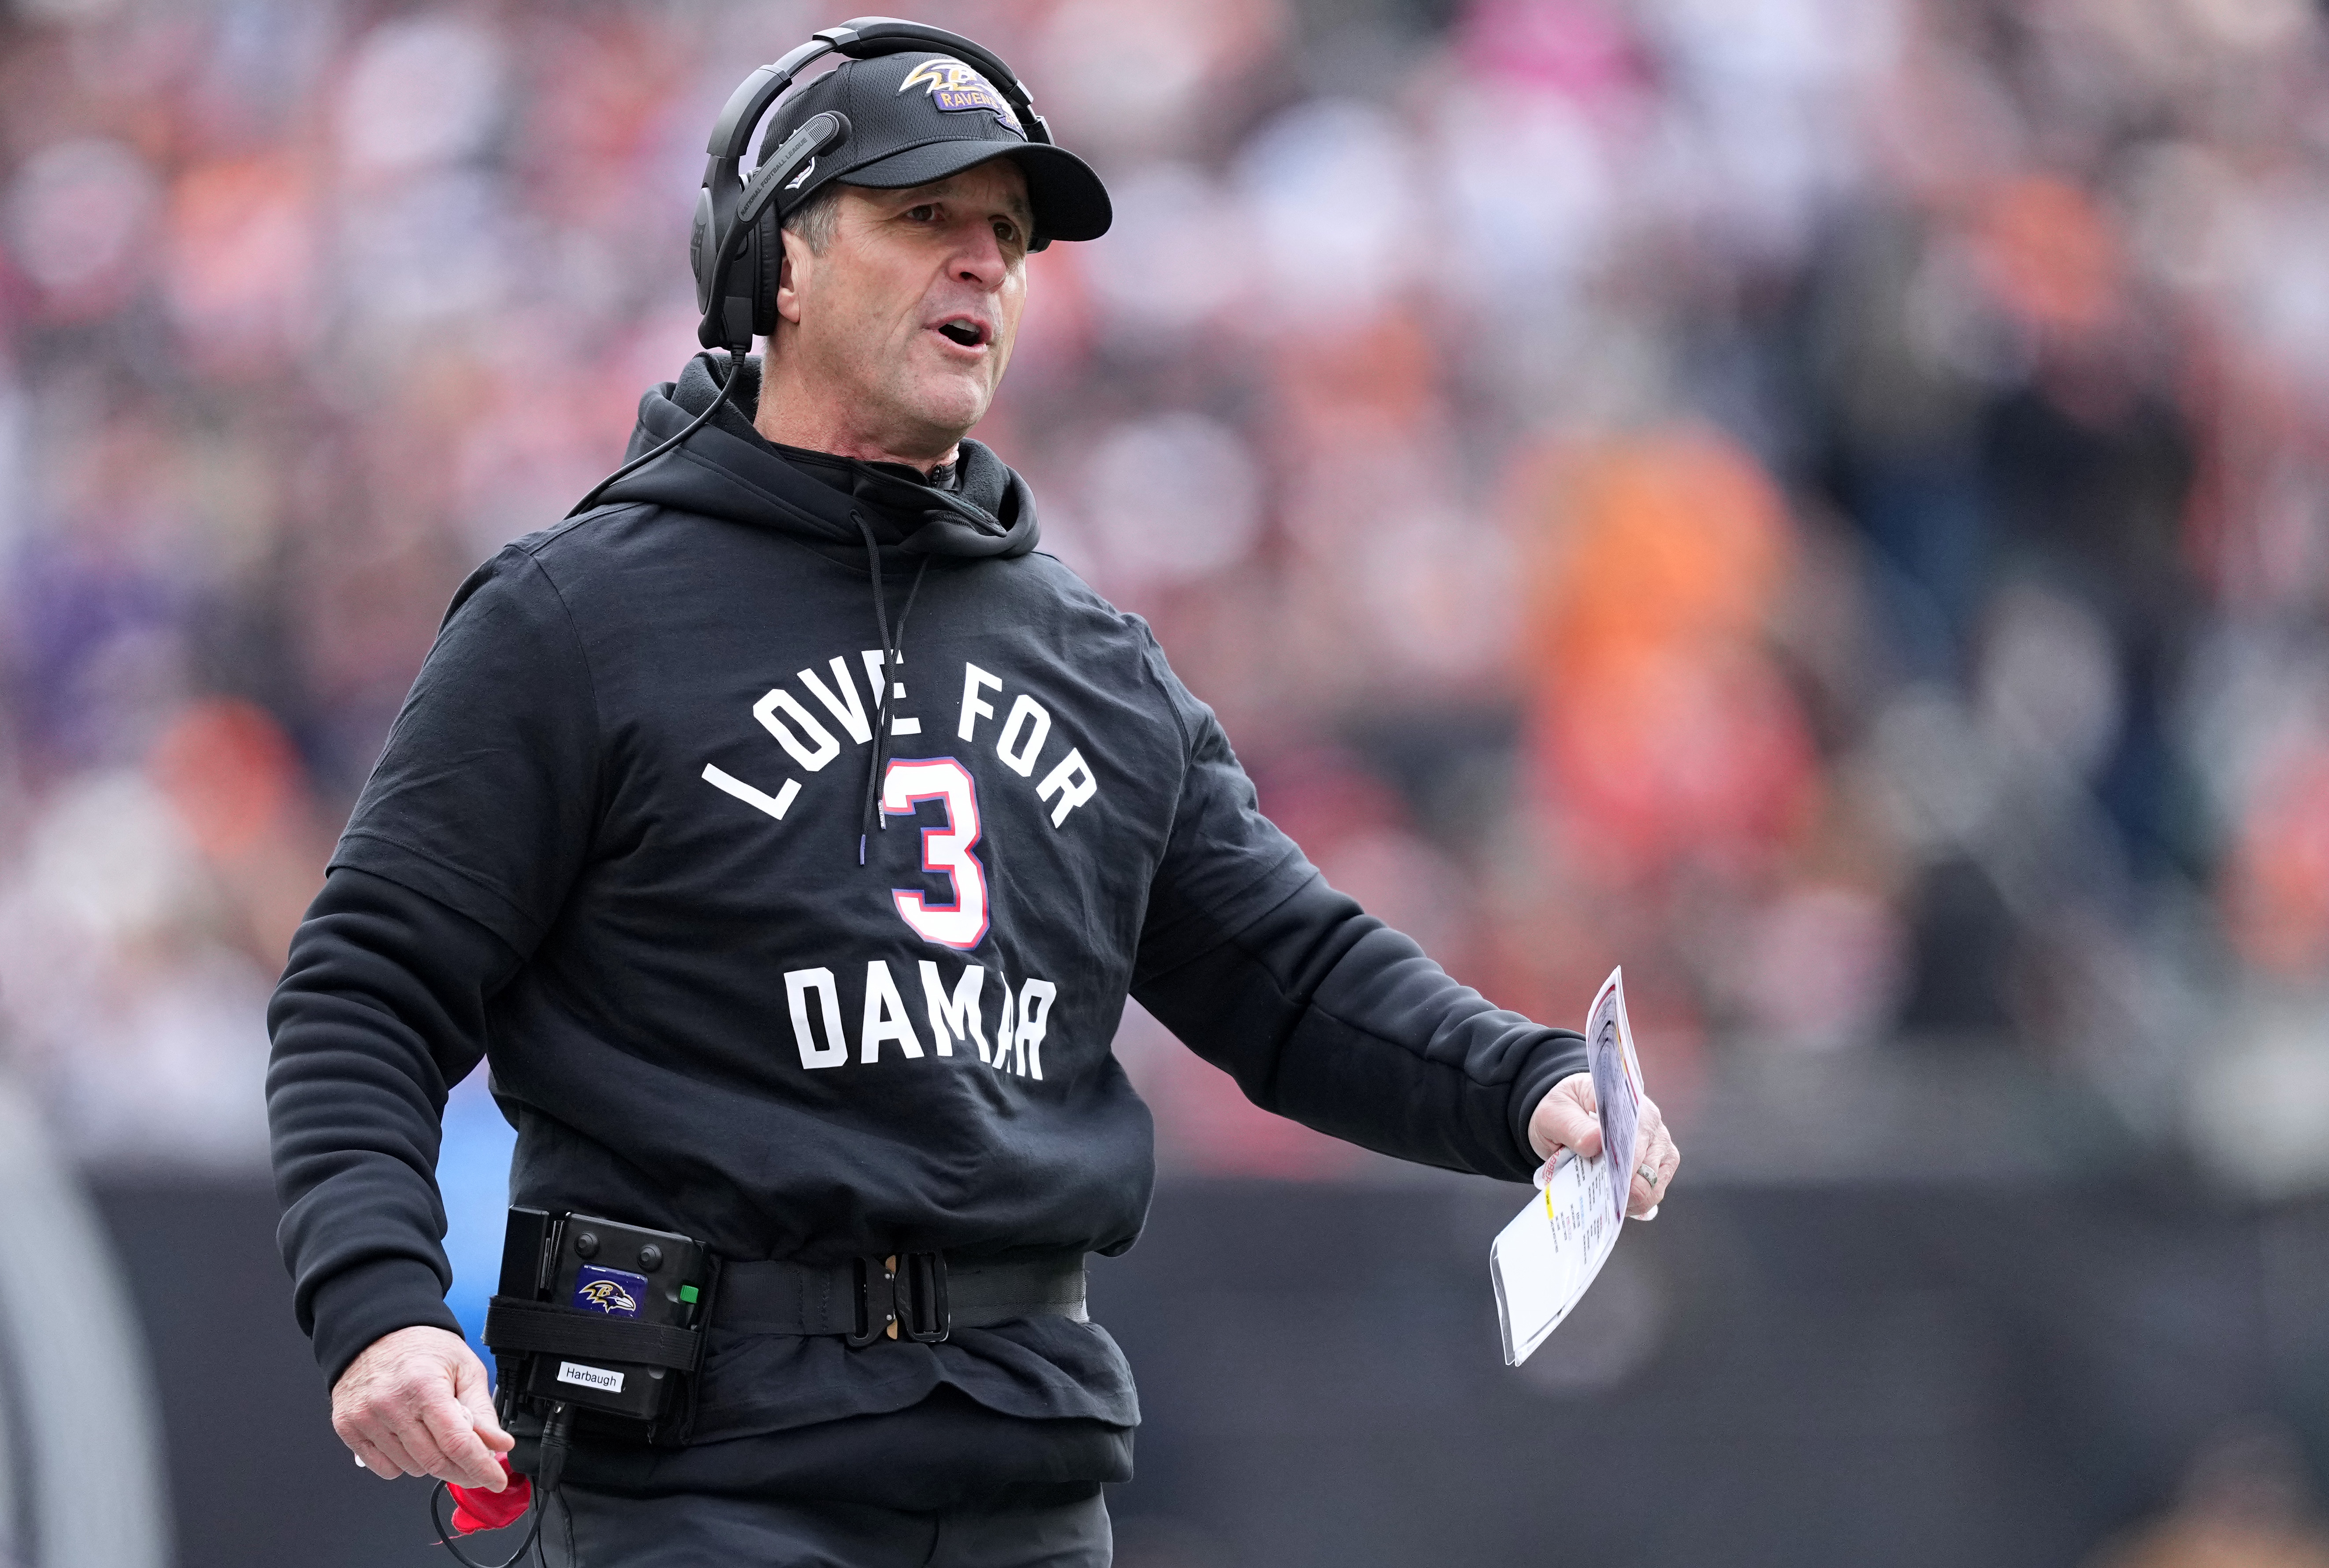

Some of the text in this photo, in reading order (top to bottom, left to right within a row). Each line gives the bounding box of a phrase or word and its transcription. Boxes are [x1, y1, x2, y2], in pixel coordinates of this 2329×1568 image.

[940, 93, 999, 109] RAVENS
[740, 137, 808, 216] NATIONAL FOOTBALL LEAGUE
[701, 649, 1097, 829] LOVE FOR
[882, 756, 990, 951] 3
[784, 960, 1057, 1080] DAMAR
[566, 1367, 617, 1386] Harbaugh
